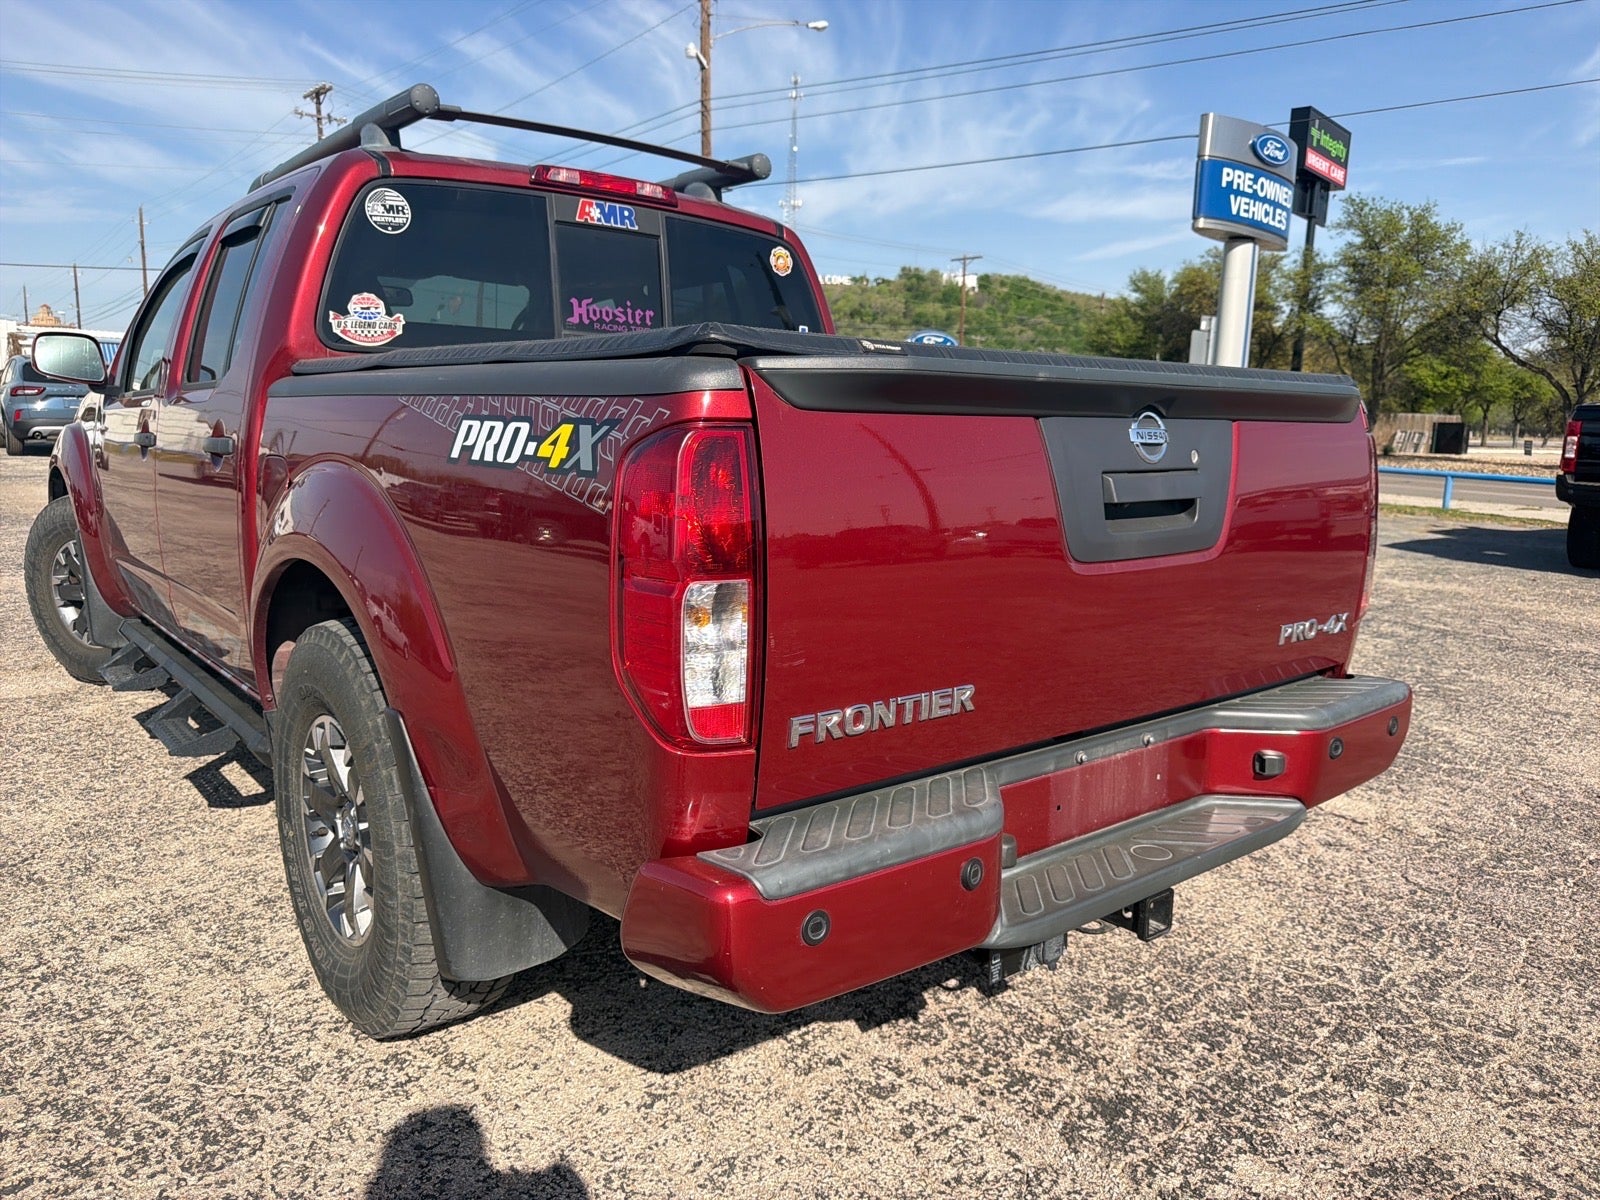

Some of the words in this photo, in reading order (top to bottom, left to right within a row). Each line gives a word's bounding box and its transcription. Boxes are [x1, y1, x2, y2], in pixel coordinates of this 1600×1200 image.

[1262, 141, 1285, 161] Ford
[1307, 151, 1330, 174] URGENT
[1330, 165, 1345, 182] CARE
[1221, 167, 1293, 209] PRE-OWNED
[576, 198, 638, 230] AMR
[1229, 194, 1287, 231] VEHICLES
[350, 320, 377, 329] LEGEND
[378, 321, 398, 330] CARS
[566, 297, 655, 326] Hoosier
[593, 322, 628, 333] RACING
[449, 418, 615, 473] PRO-4X
[1278, 612, 1349, 646] PRO-4X
[787, 684, 976, 749] FRONTIER
